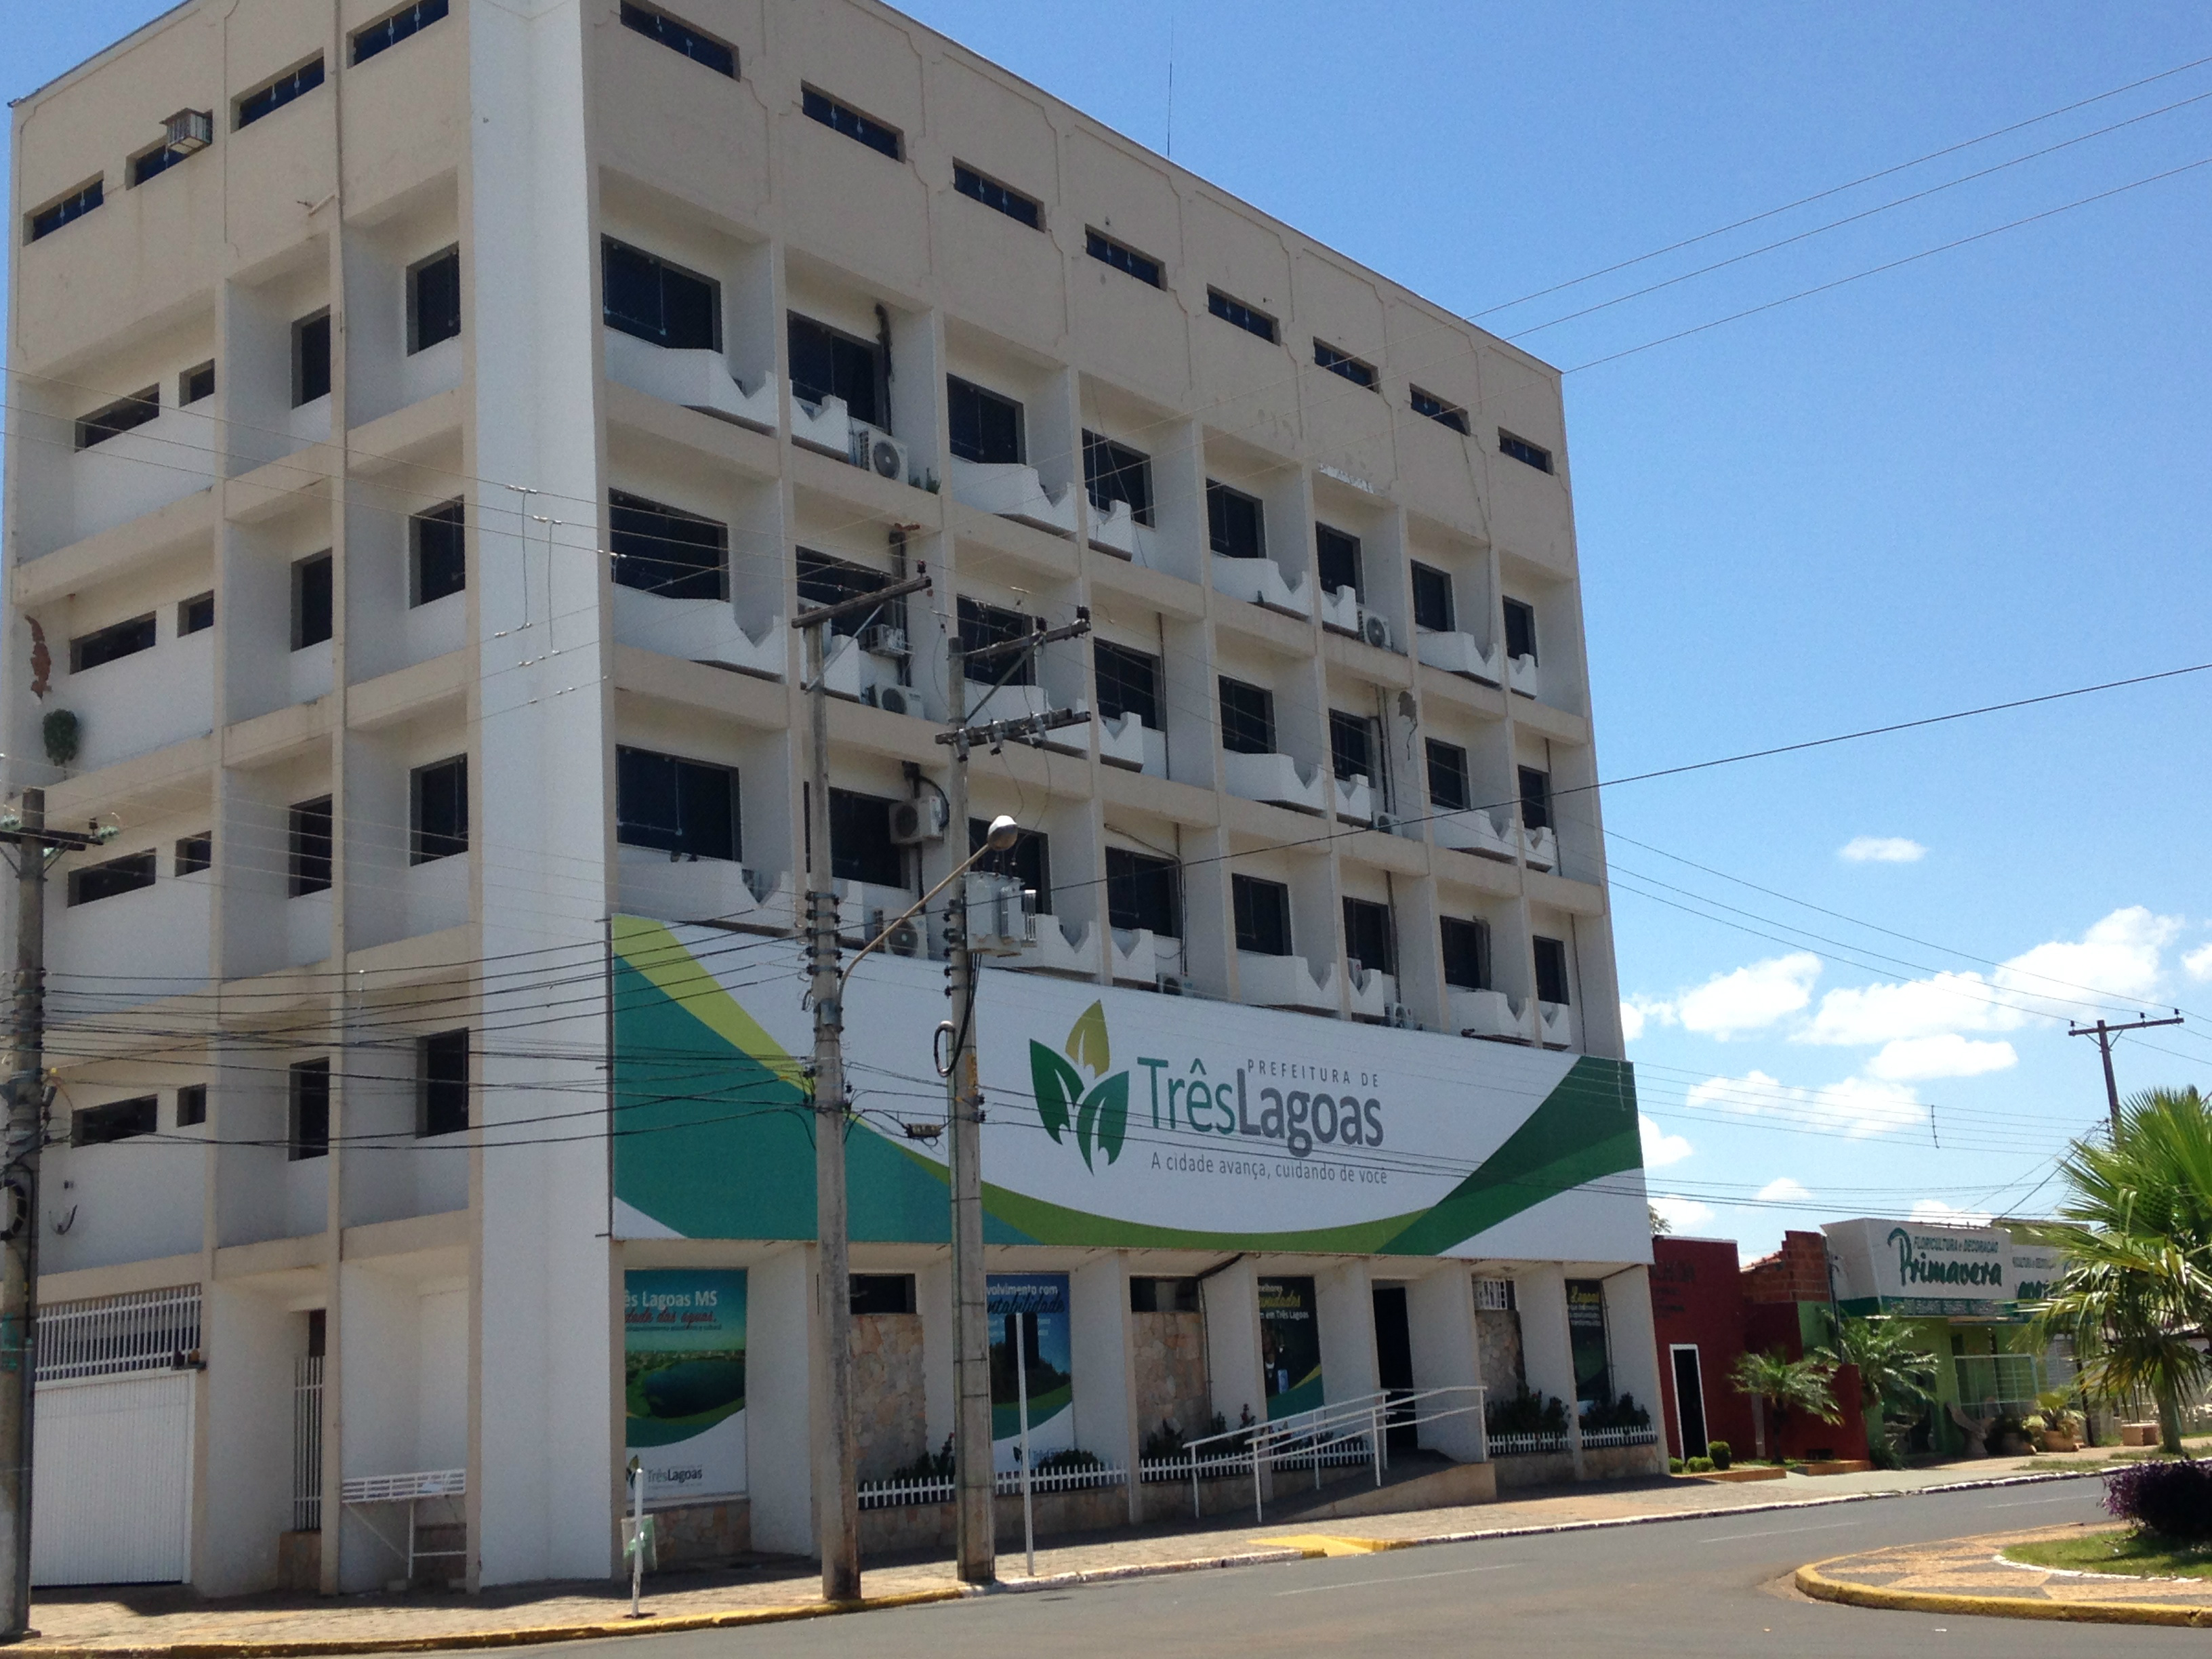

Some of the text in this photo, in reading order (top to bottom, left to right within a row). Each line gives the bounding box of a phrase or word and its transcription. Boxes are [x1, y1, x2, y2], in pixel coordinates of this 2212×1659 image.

[1248, 1059, 1378, 1088] PREFEITURA DE
[1151, 1152, 1161, 1170] A
[1166, 1153, 1214, 1173] cidade
[1219, 1159, 1271, 1179] avança,
[1275, 1161, 1335, 1181] cuidando
[1340, 1164, 1355, 1182] de
[1887, 1227, 2002, 1287] Primavera
[642, 1290, 691, 1311] Lagoas
[695, 1290, 717, 1307] MS
